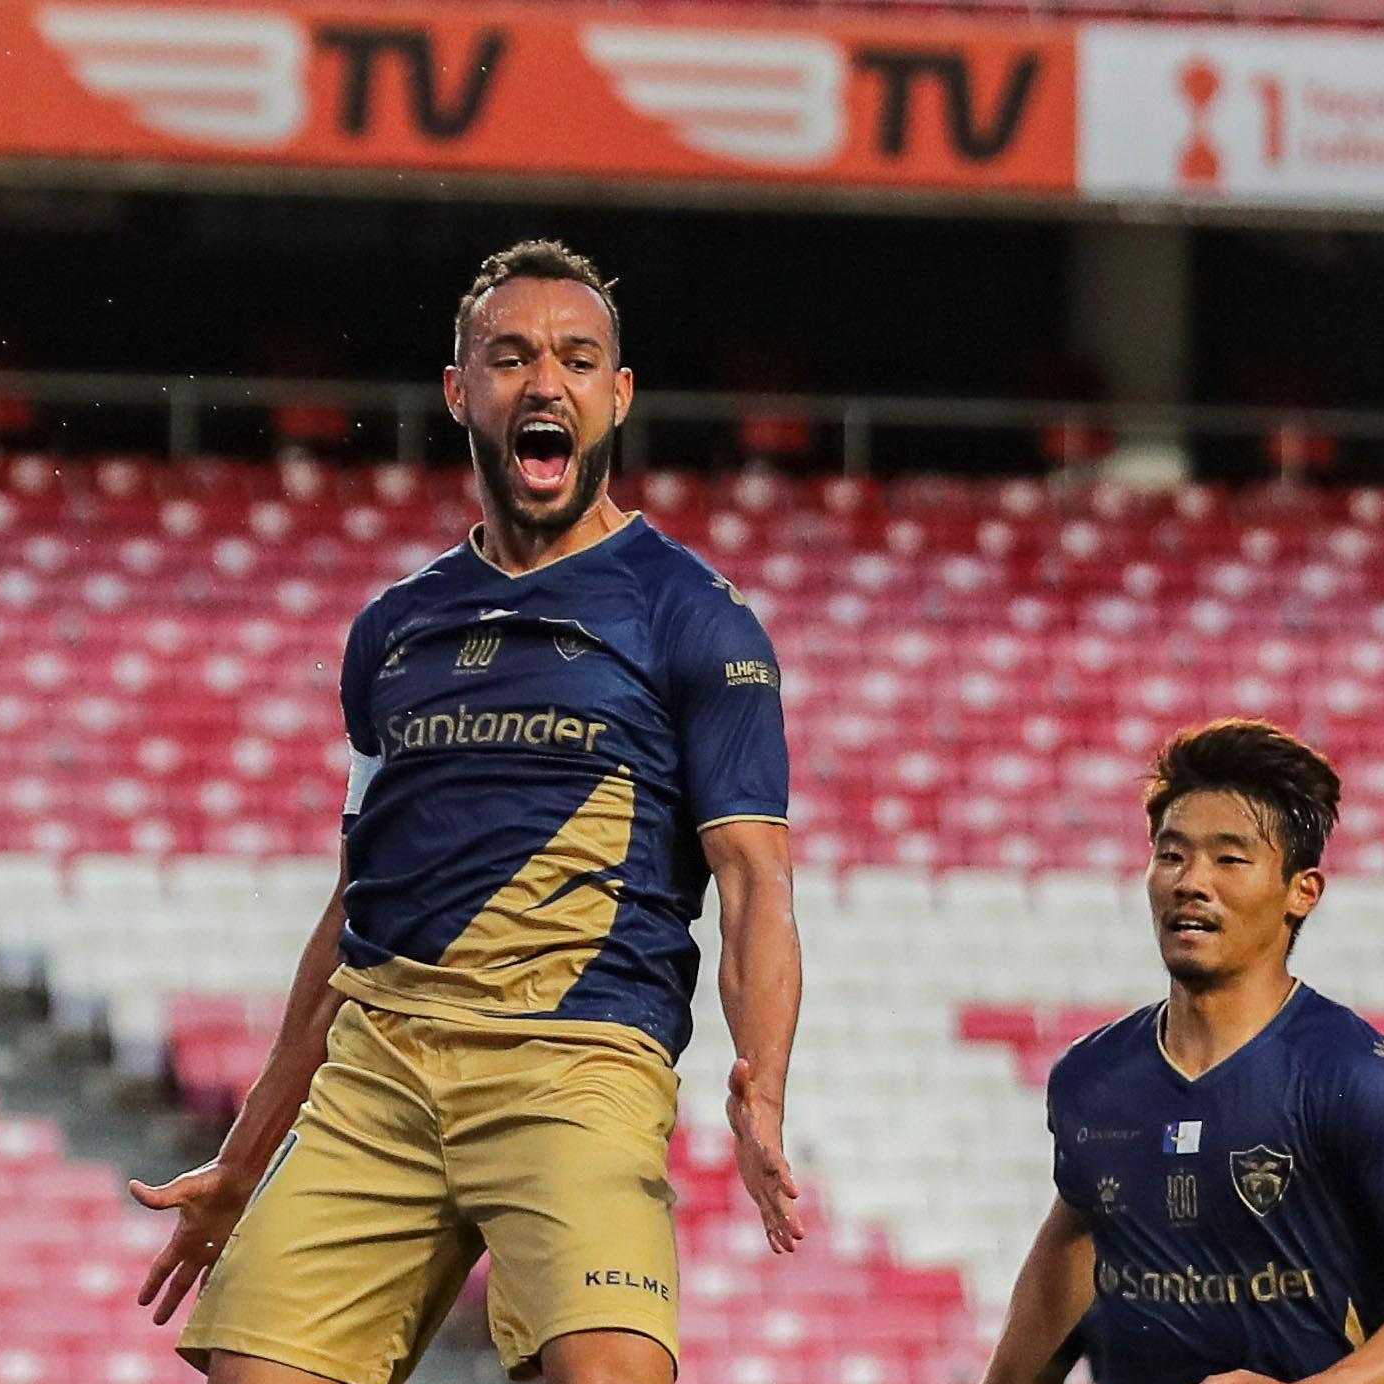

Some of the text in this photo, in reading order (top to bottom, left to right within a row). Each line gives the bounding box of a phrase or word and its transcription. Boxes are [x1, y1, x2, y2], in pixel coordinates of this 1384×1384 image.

[1252, 72, 1287, 168] 1
[386, 704, 607, 752] Santander
[585, 1270, 669, 1301] KELME
